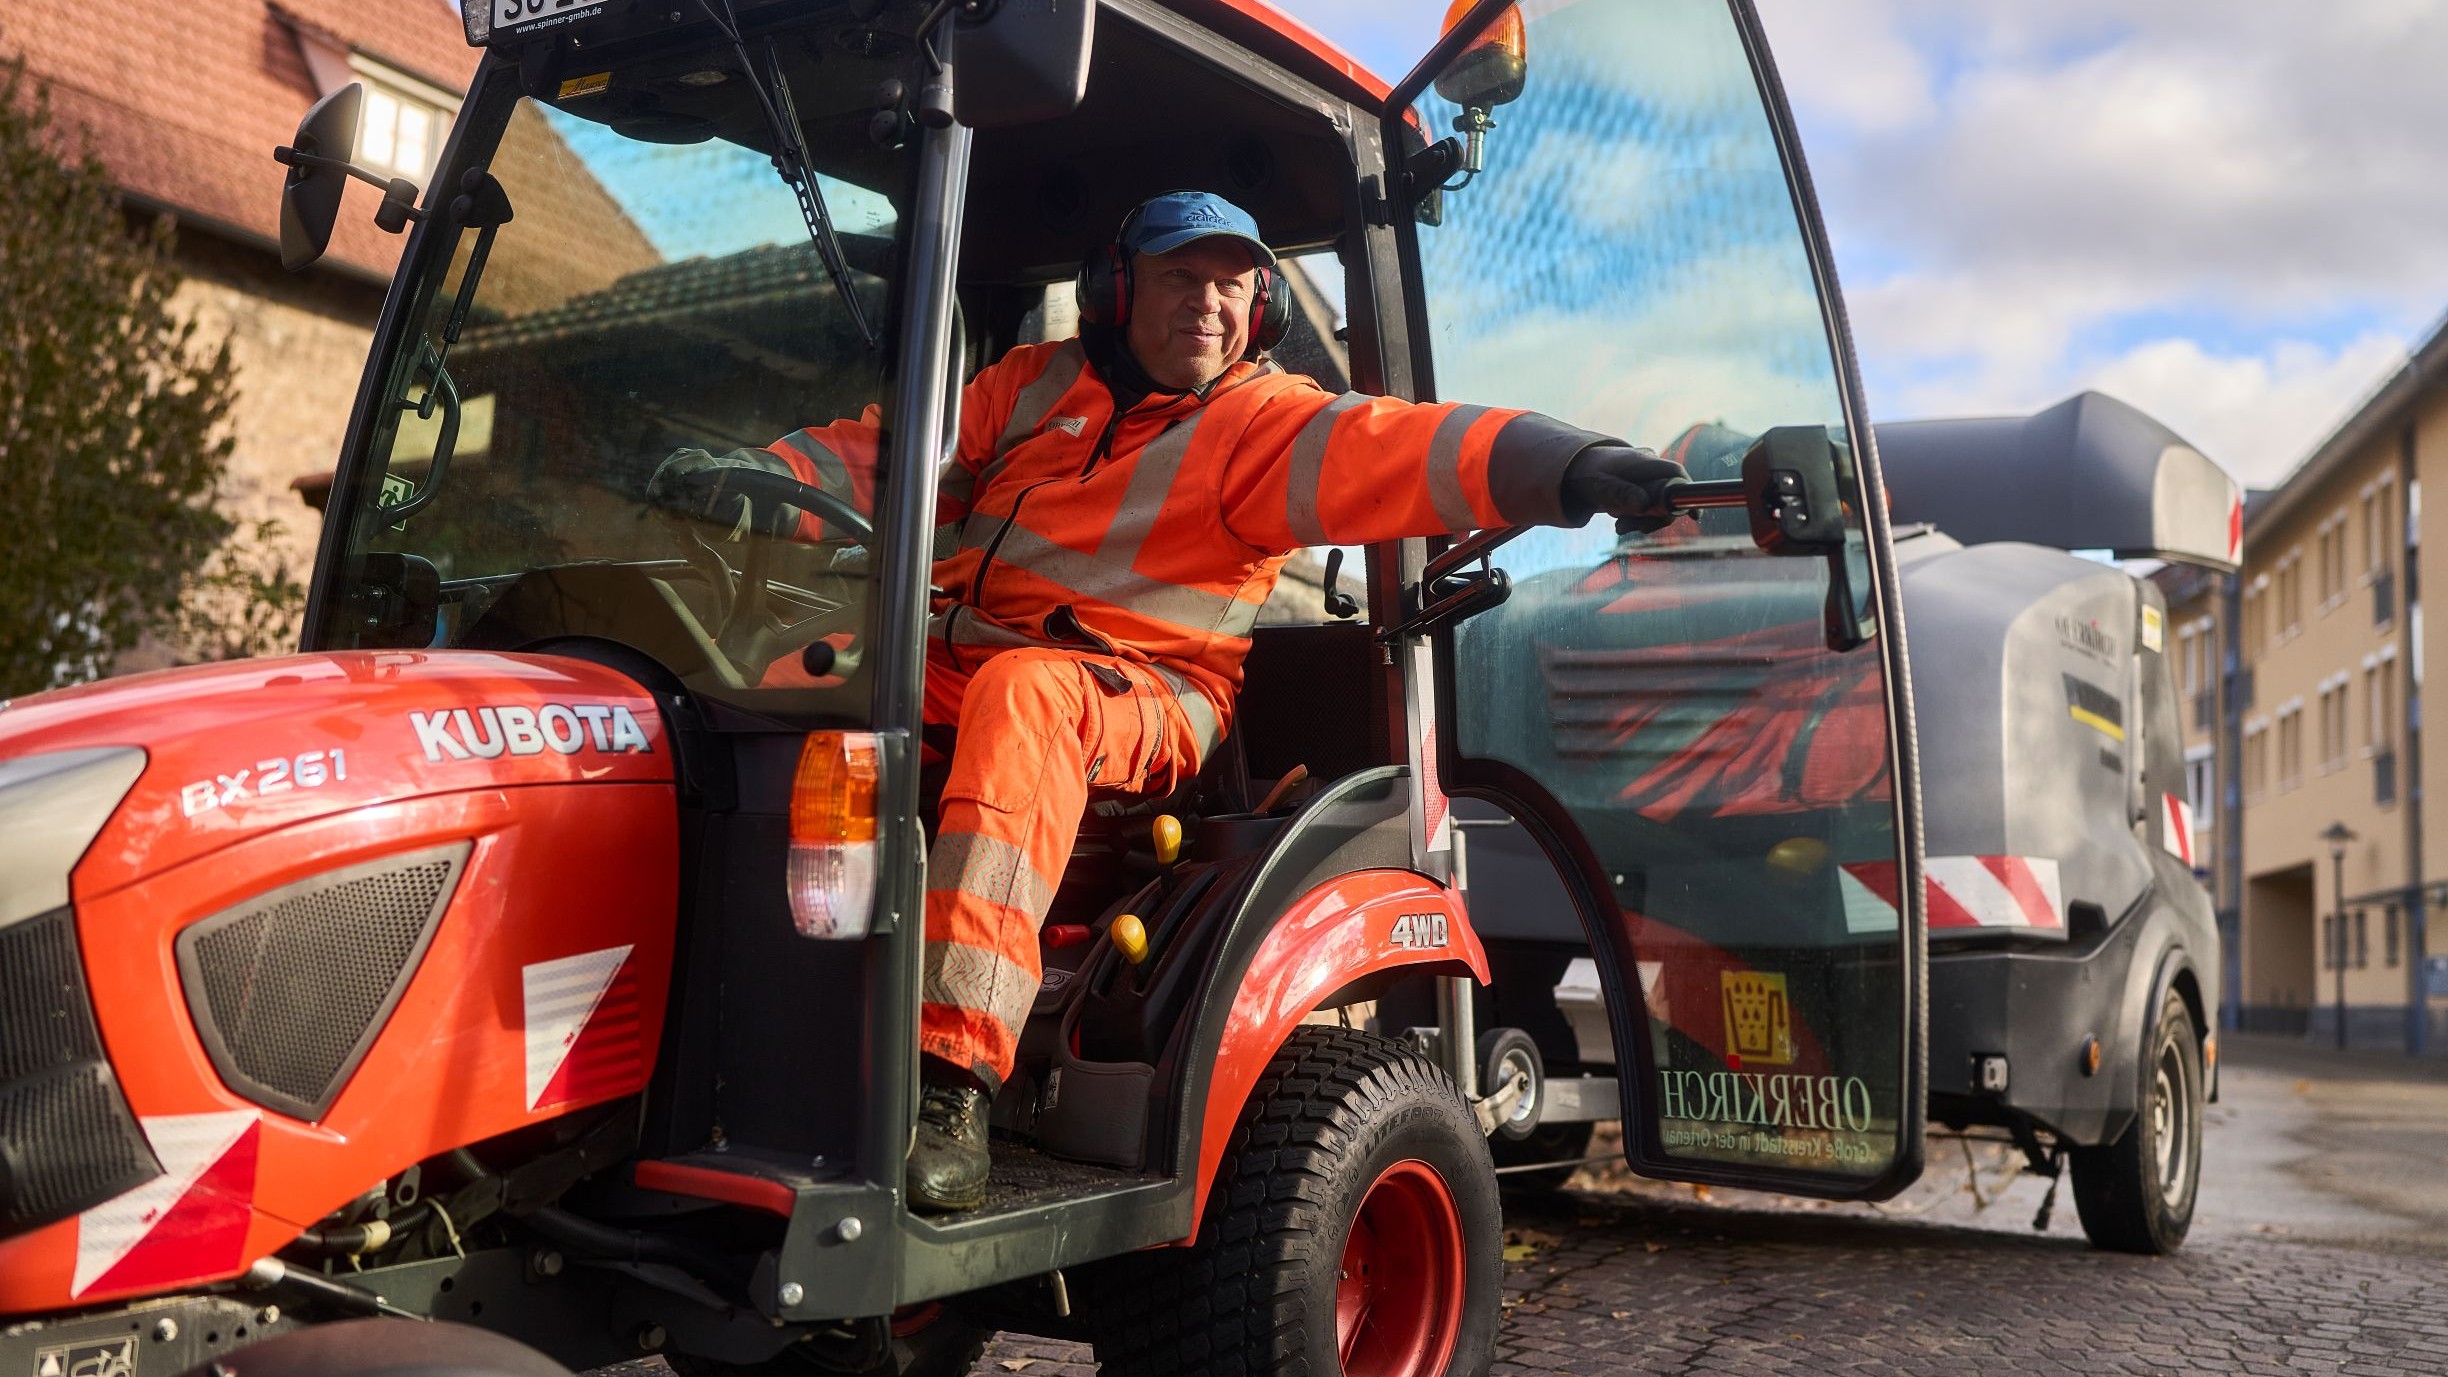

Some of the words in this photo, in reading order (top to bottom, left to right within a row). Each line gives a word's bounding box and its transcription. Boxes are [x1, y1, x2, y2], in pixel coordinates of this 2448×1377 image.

[515, 6, 602, 34] www.spinner-gmbh.de
[409, 704, 655, 763] KUBOTA
[181, 748, 347, 818] BX261
[1390, 912, 1449, 950] 4WD
